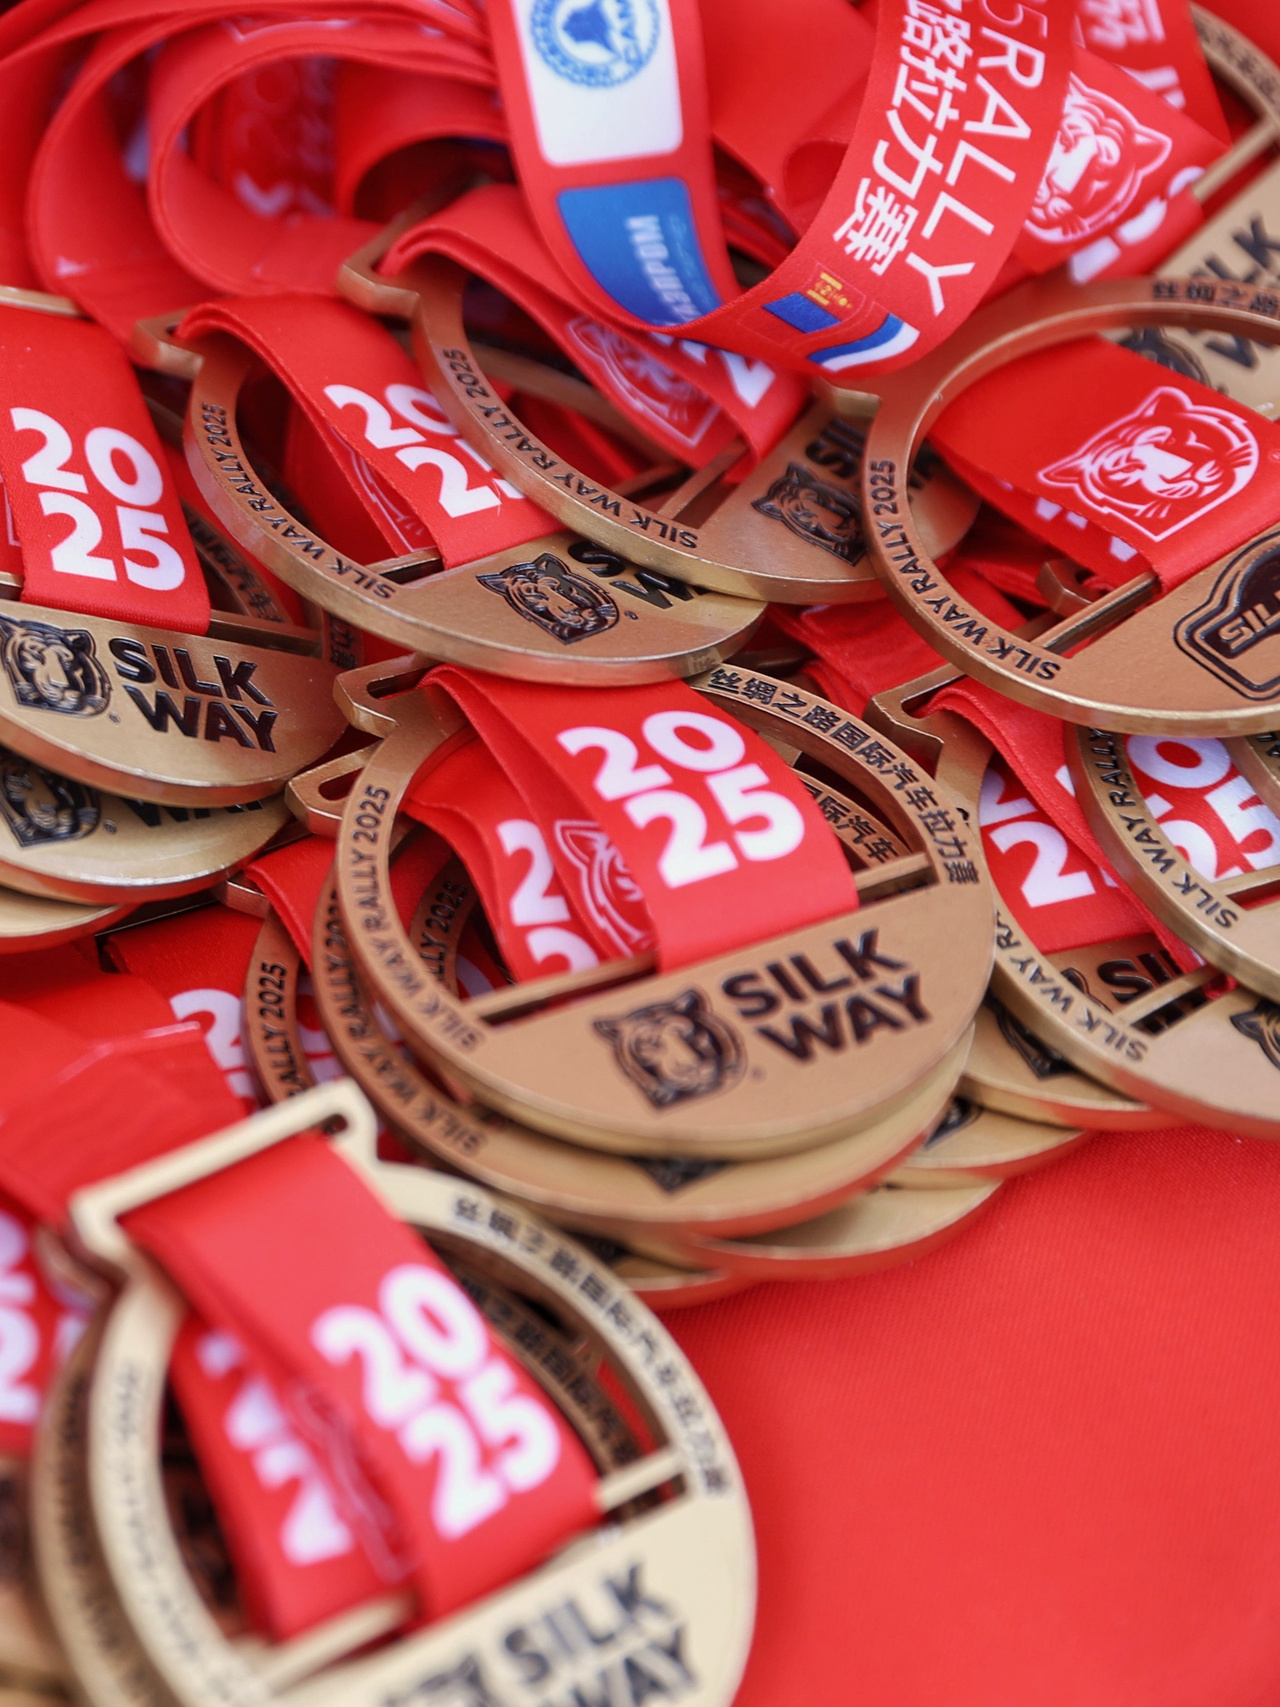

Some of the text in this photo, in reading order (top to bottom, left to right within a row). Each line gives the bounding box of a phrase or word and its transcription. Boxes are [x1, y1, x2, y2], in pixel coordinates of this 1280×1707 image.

[832, 0, 974, 277] 路拉力赛
[9, 406, 165, 508] 20
[200, 401, 234, 449] 2025
[442, 348, 700, 549] SILK WAY RALLY 2025
[210, 447, 277, 513] RALLY
[41, 491, 187, 592] 25
[262, 514, 327, 562] WAY
[326, 556, 398, 601] SILK
[869, 459, 1063, 684] SILK WAY RALLY 2025
[107, 635, 278, 709] SILK
[121, 683, 281, 754] WAY
[558, 709, 747, 801] 20
[352, 783, 393, 845] 2025
[706, 666, 981, 886] 丝绸之路国际汽车拉力赛
[625, 767, 807, 889] 25
[804, 781, 902, 865] 际汽车
[1119, 813, 1177, 874] WAY
[1172, 871, 1241, 930] SILK
[258, 962, 289, 1020] 2025
[721, 928, 908, 1018] SILK
[754, 975, 934, 1063] WAY
[310, 1261, 490, 1430] 20
[396, 1360, 563, 1542] 25
[502, 1560, 674, 1688] SILK
